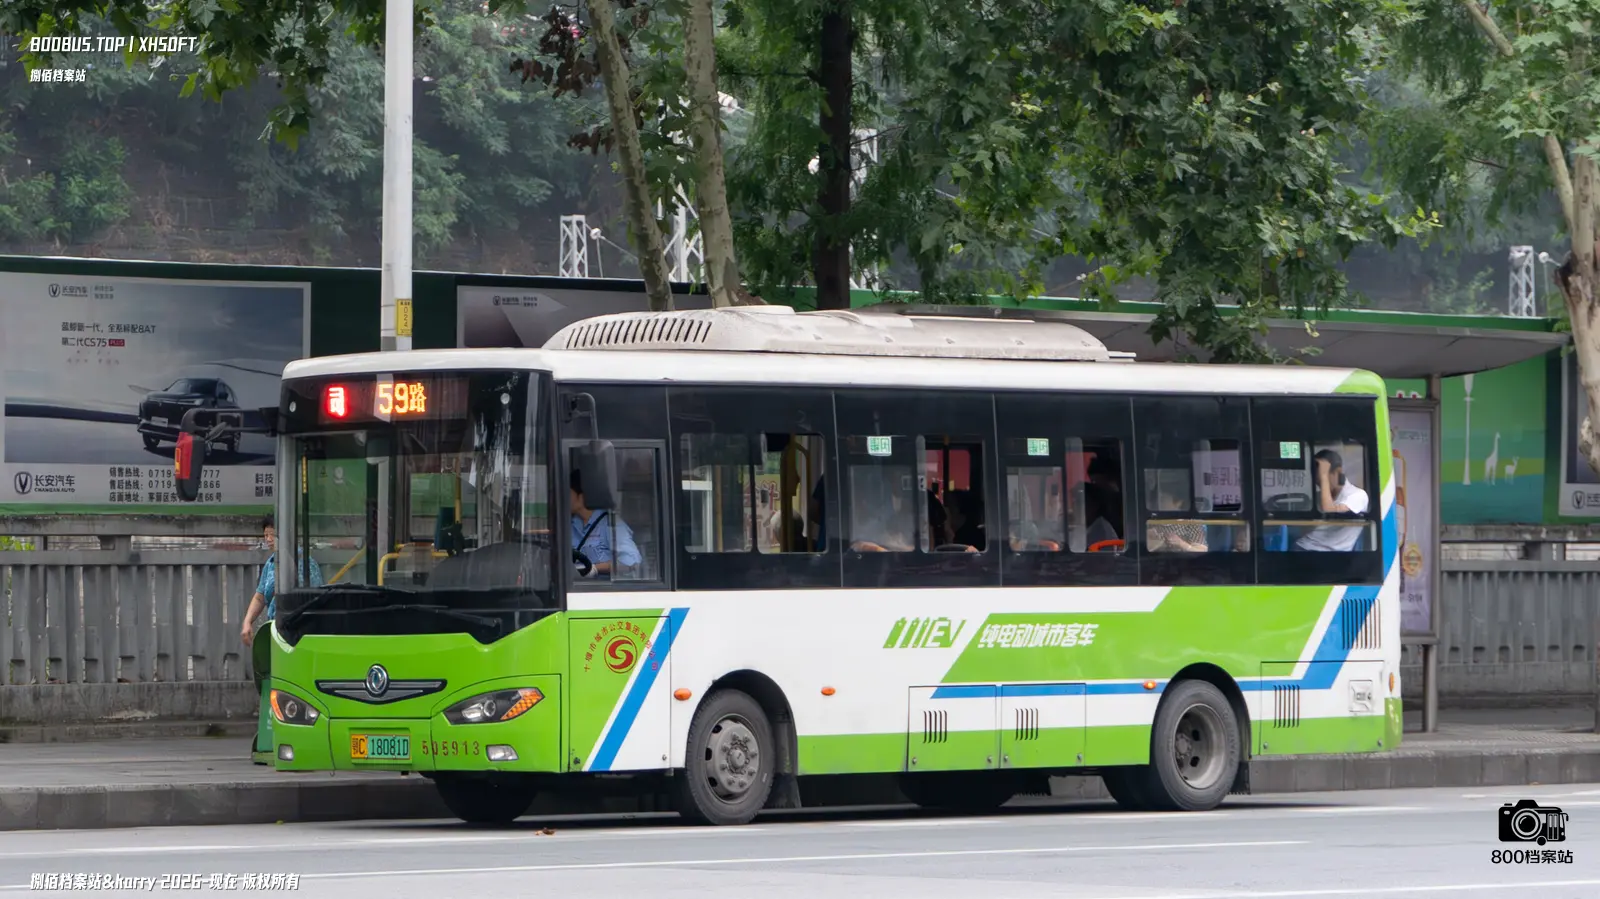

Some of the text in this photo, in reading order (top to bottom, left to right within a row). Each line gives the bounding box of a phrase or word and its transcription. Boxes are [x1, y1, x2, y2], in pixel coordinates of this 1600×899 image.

[378, 382, 427, 414] 59路
[34, 474, 75, 487] 长安汽车
[977, 622, 1099, 649] 纯电动城市客车
[371, 738, 409, 756] 18081D
[421, 740, 480, 756] 505913
